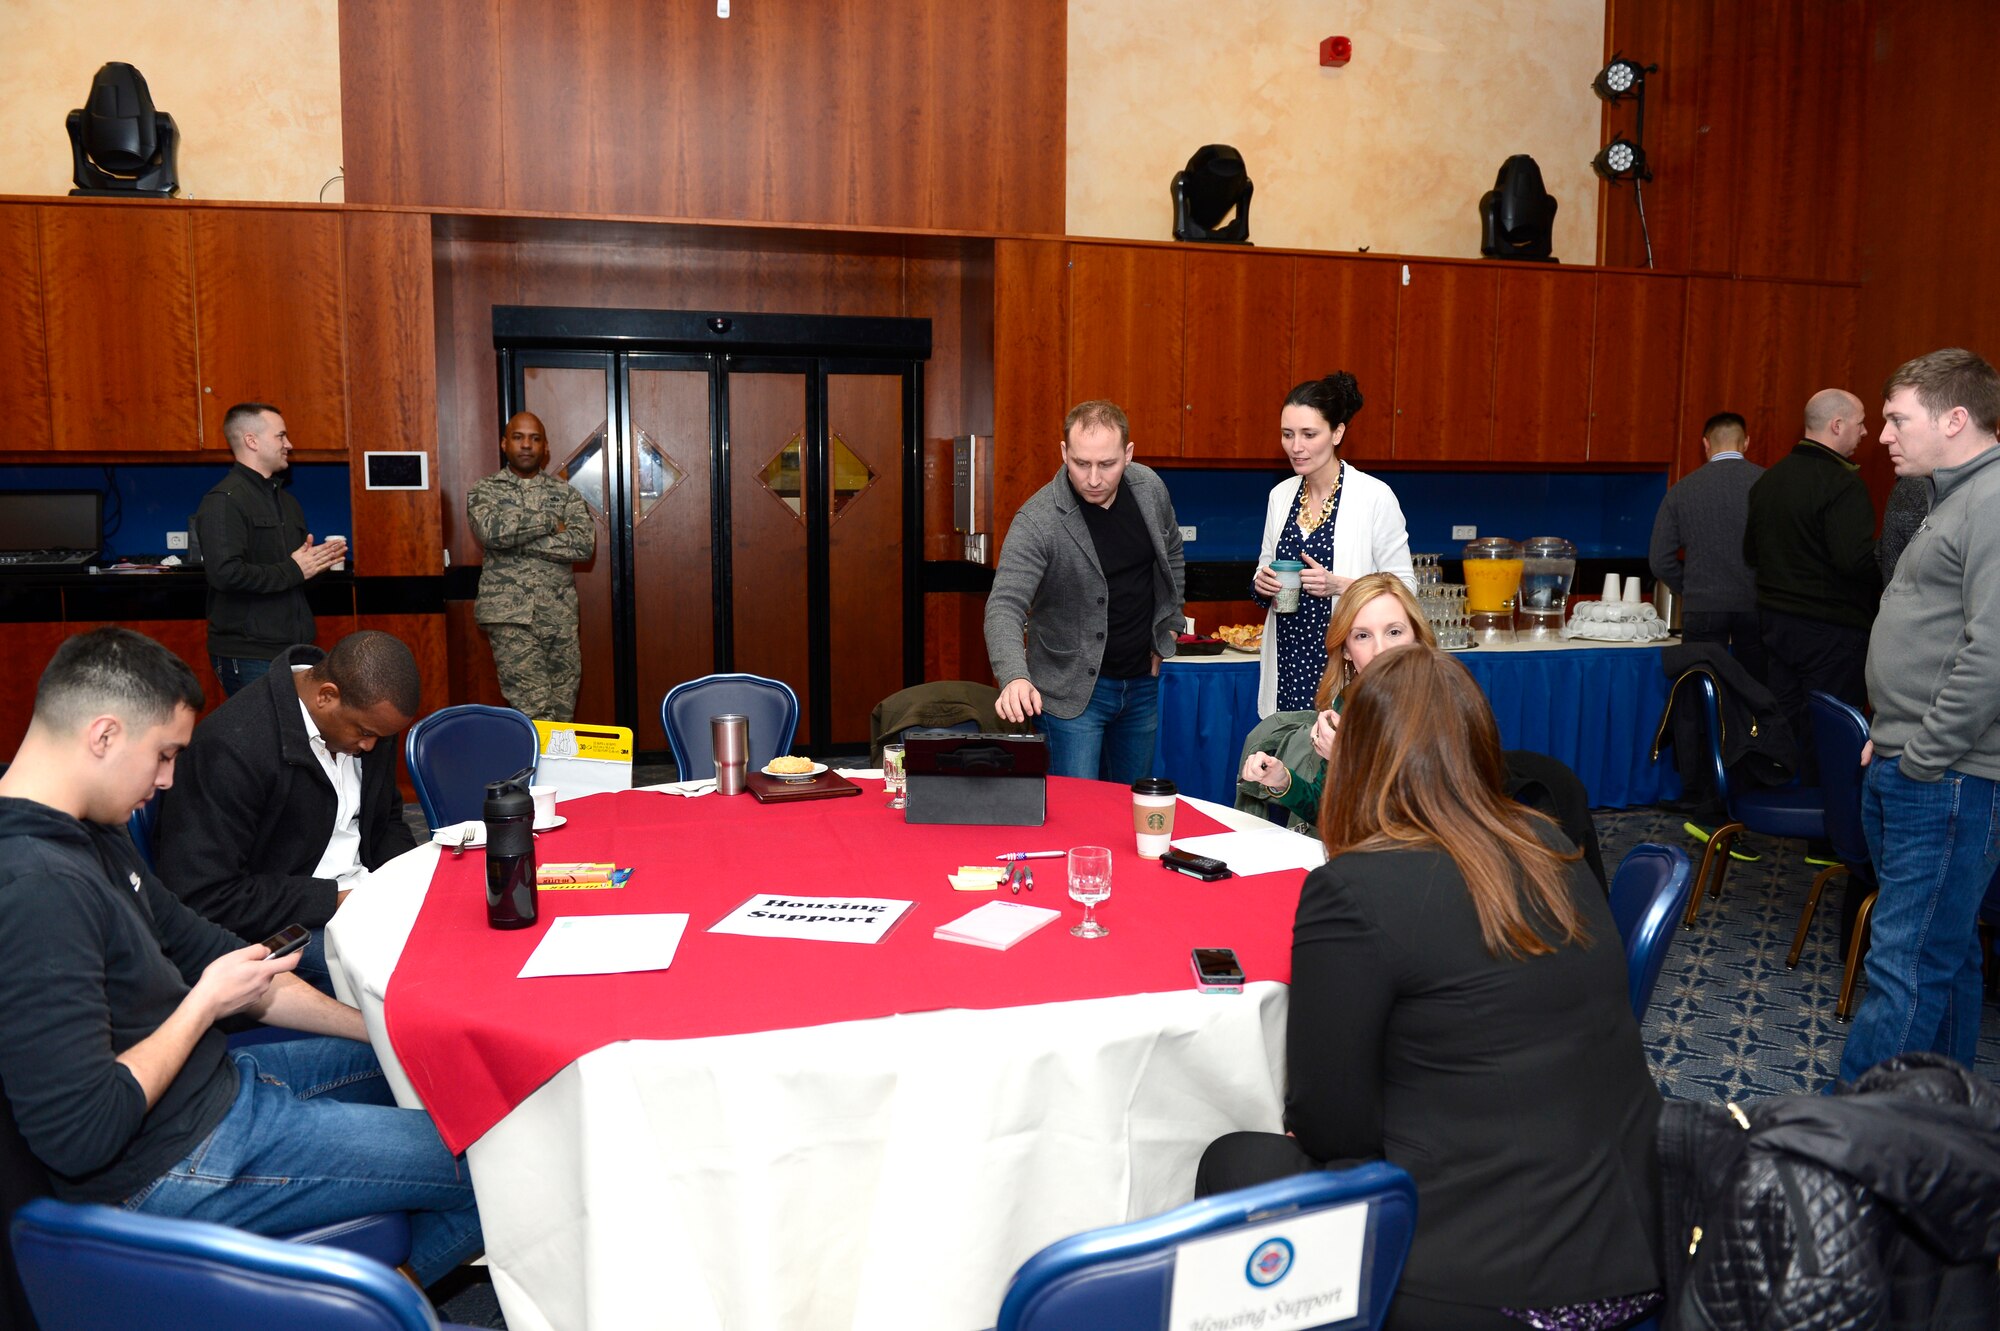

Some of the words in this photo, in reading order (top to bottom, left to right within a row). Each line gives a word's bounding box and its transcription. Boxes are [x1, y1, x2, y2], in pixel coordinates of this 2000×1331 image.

[763, 899, 888, 913] Housing
[747, 910, 879, 924] Support
[1190, 1305, 1268, 1331] Housing
[1270, 1287, 1343, 1320] Support
